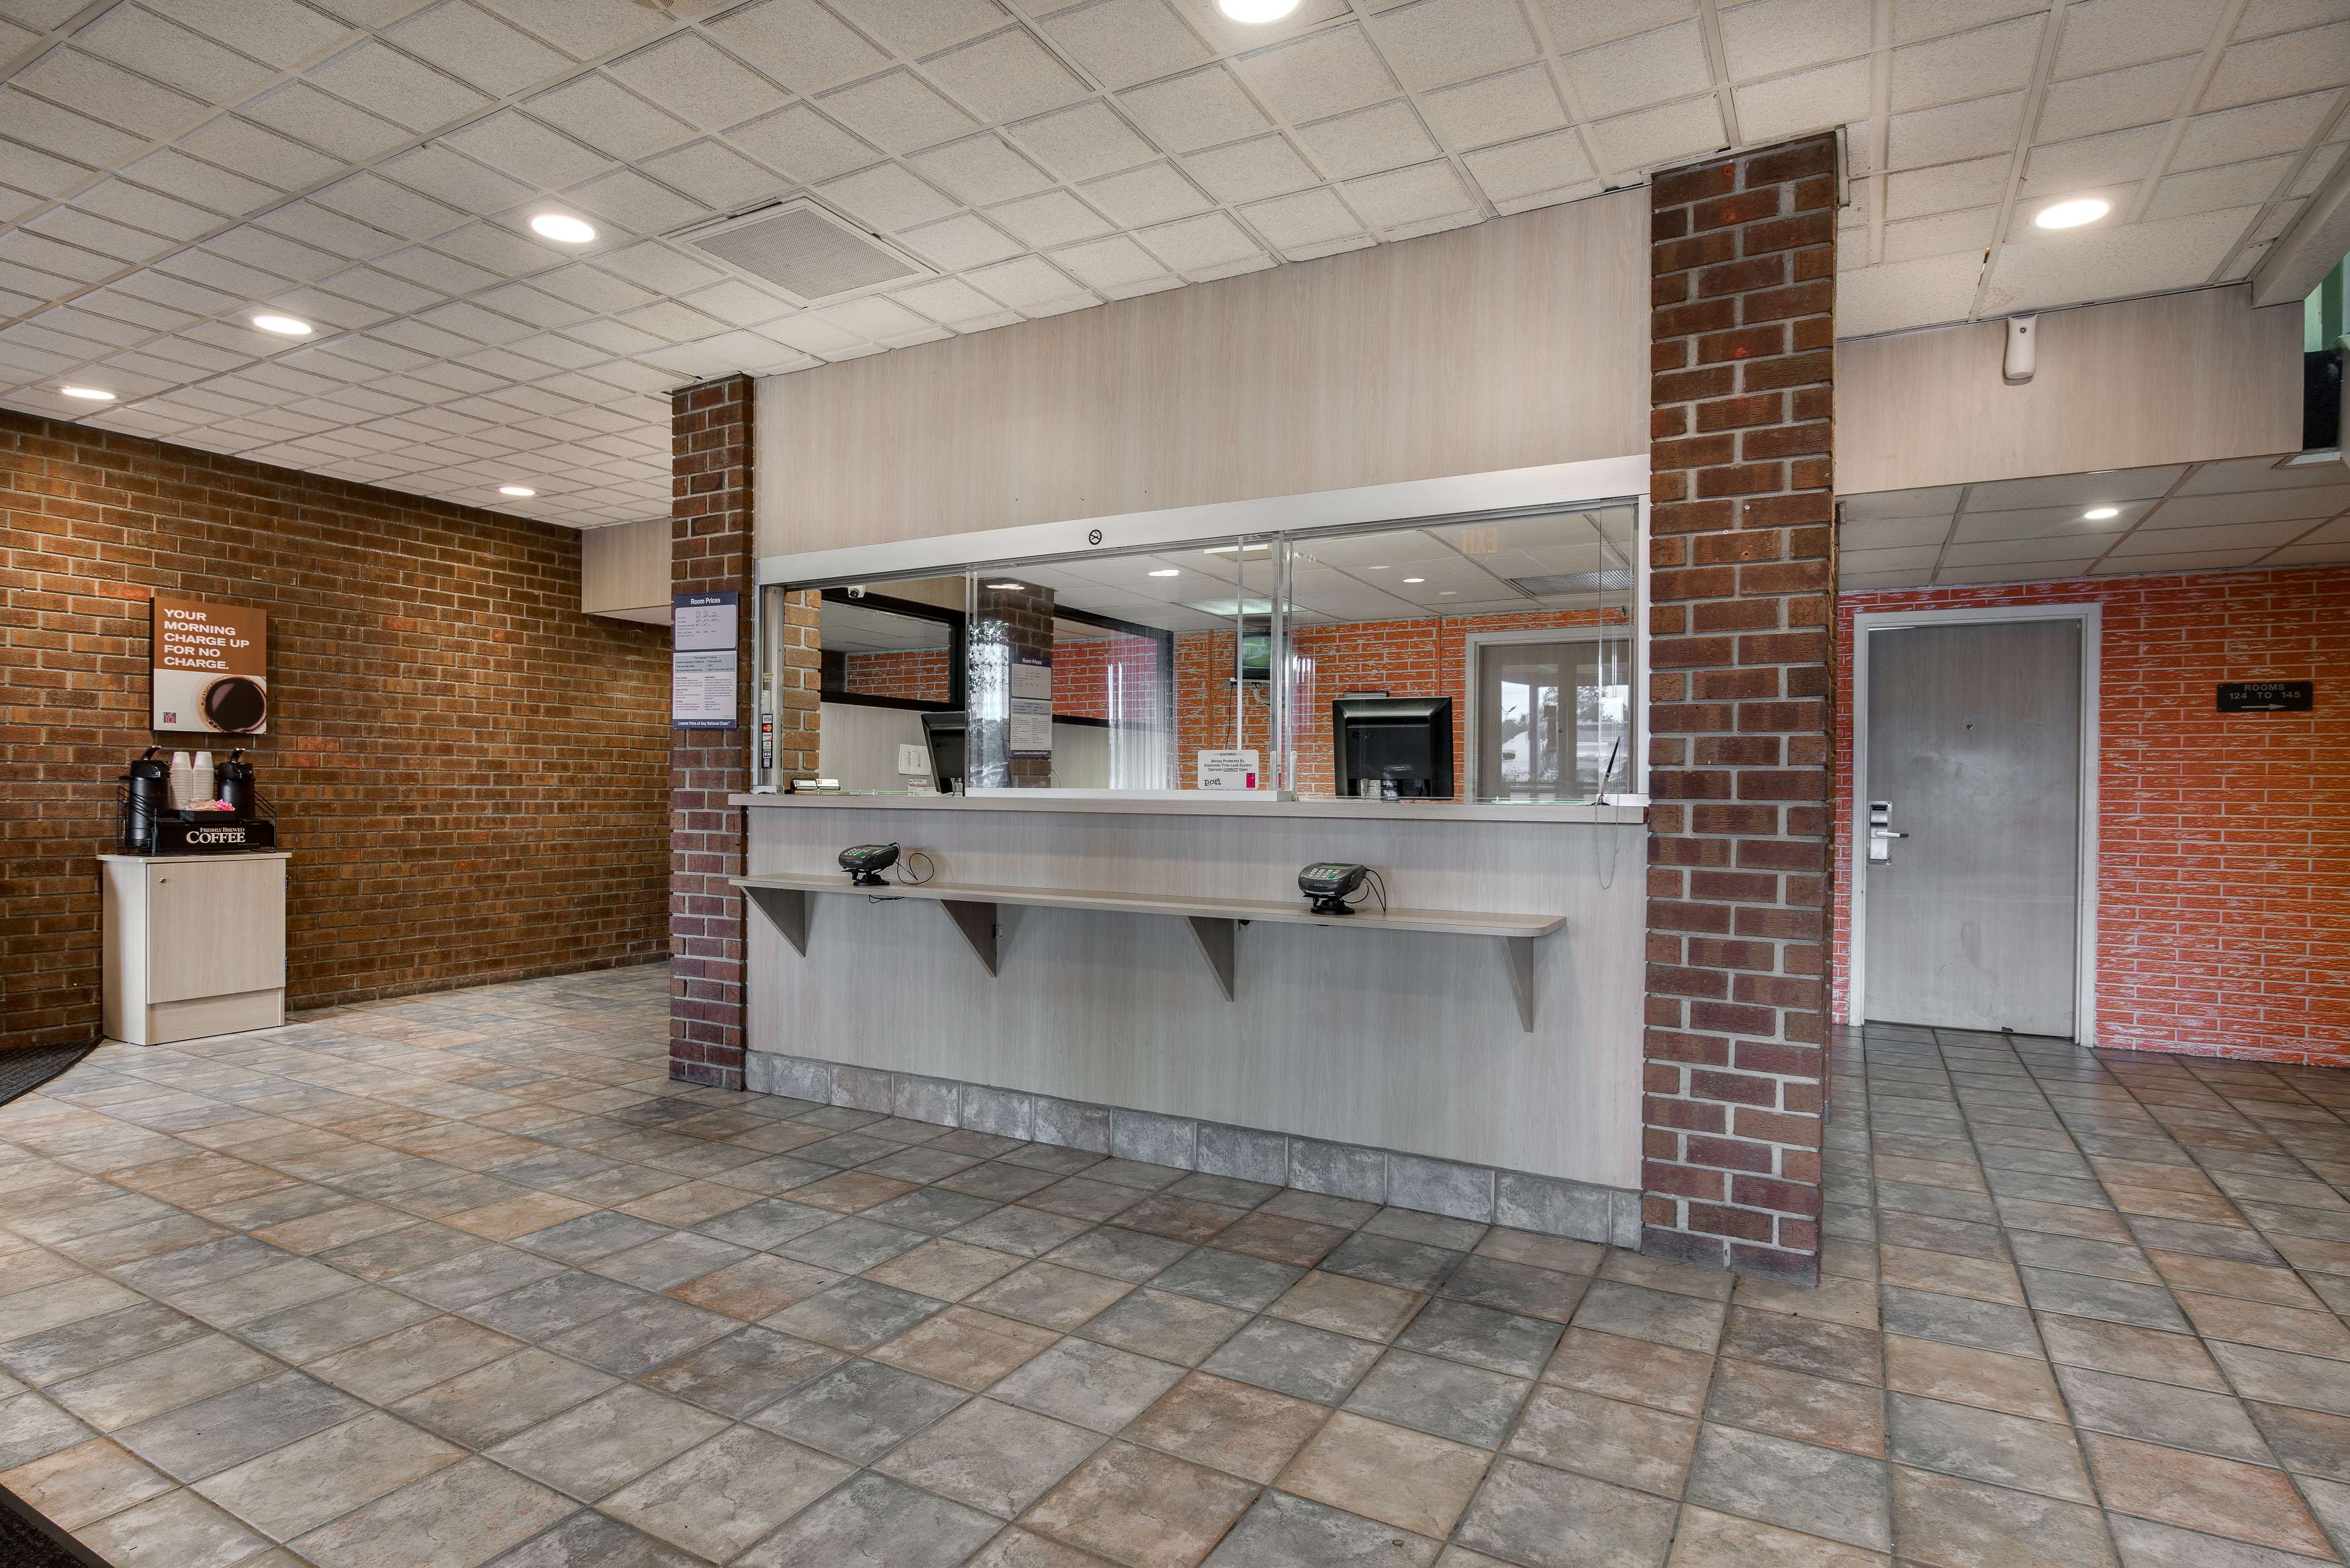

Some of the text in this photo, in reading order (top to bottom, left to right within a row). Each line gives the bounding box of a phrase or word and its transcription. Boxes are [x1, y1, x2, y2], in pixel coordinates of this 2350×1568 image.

[164, 608, 207, 621] YOUR
[164, 621, 236, 636] MORNING
[164, 632, 250, 648] CHARGE UP
[164, 644, 220, 657] FOR NO
[164, 656, 229, 669] CHARGE.
[186, 831, 246, 844] COFFEE
